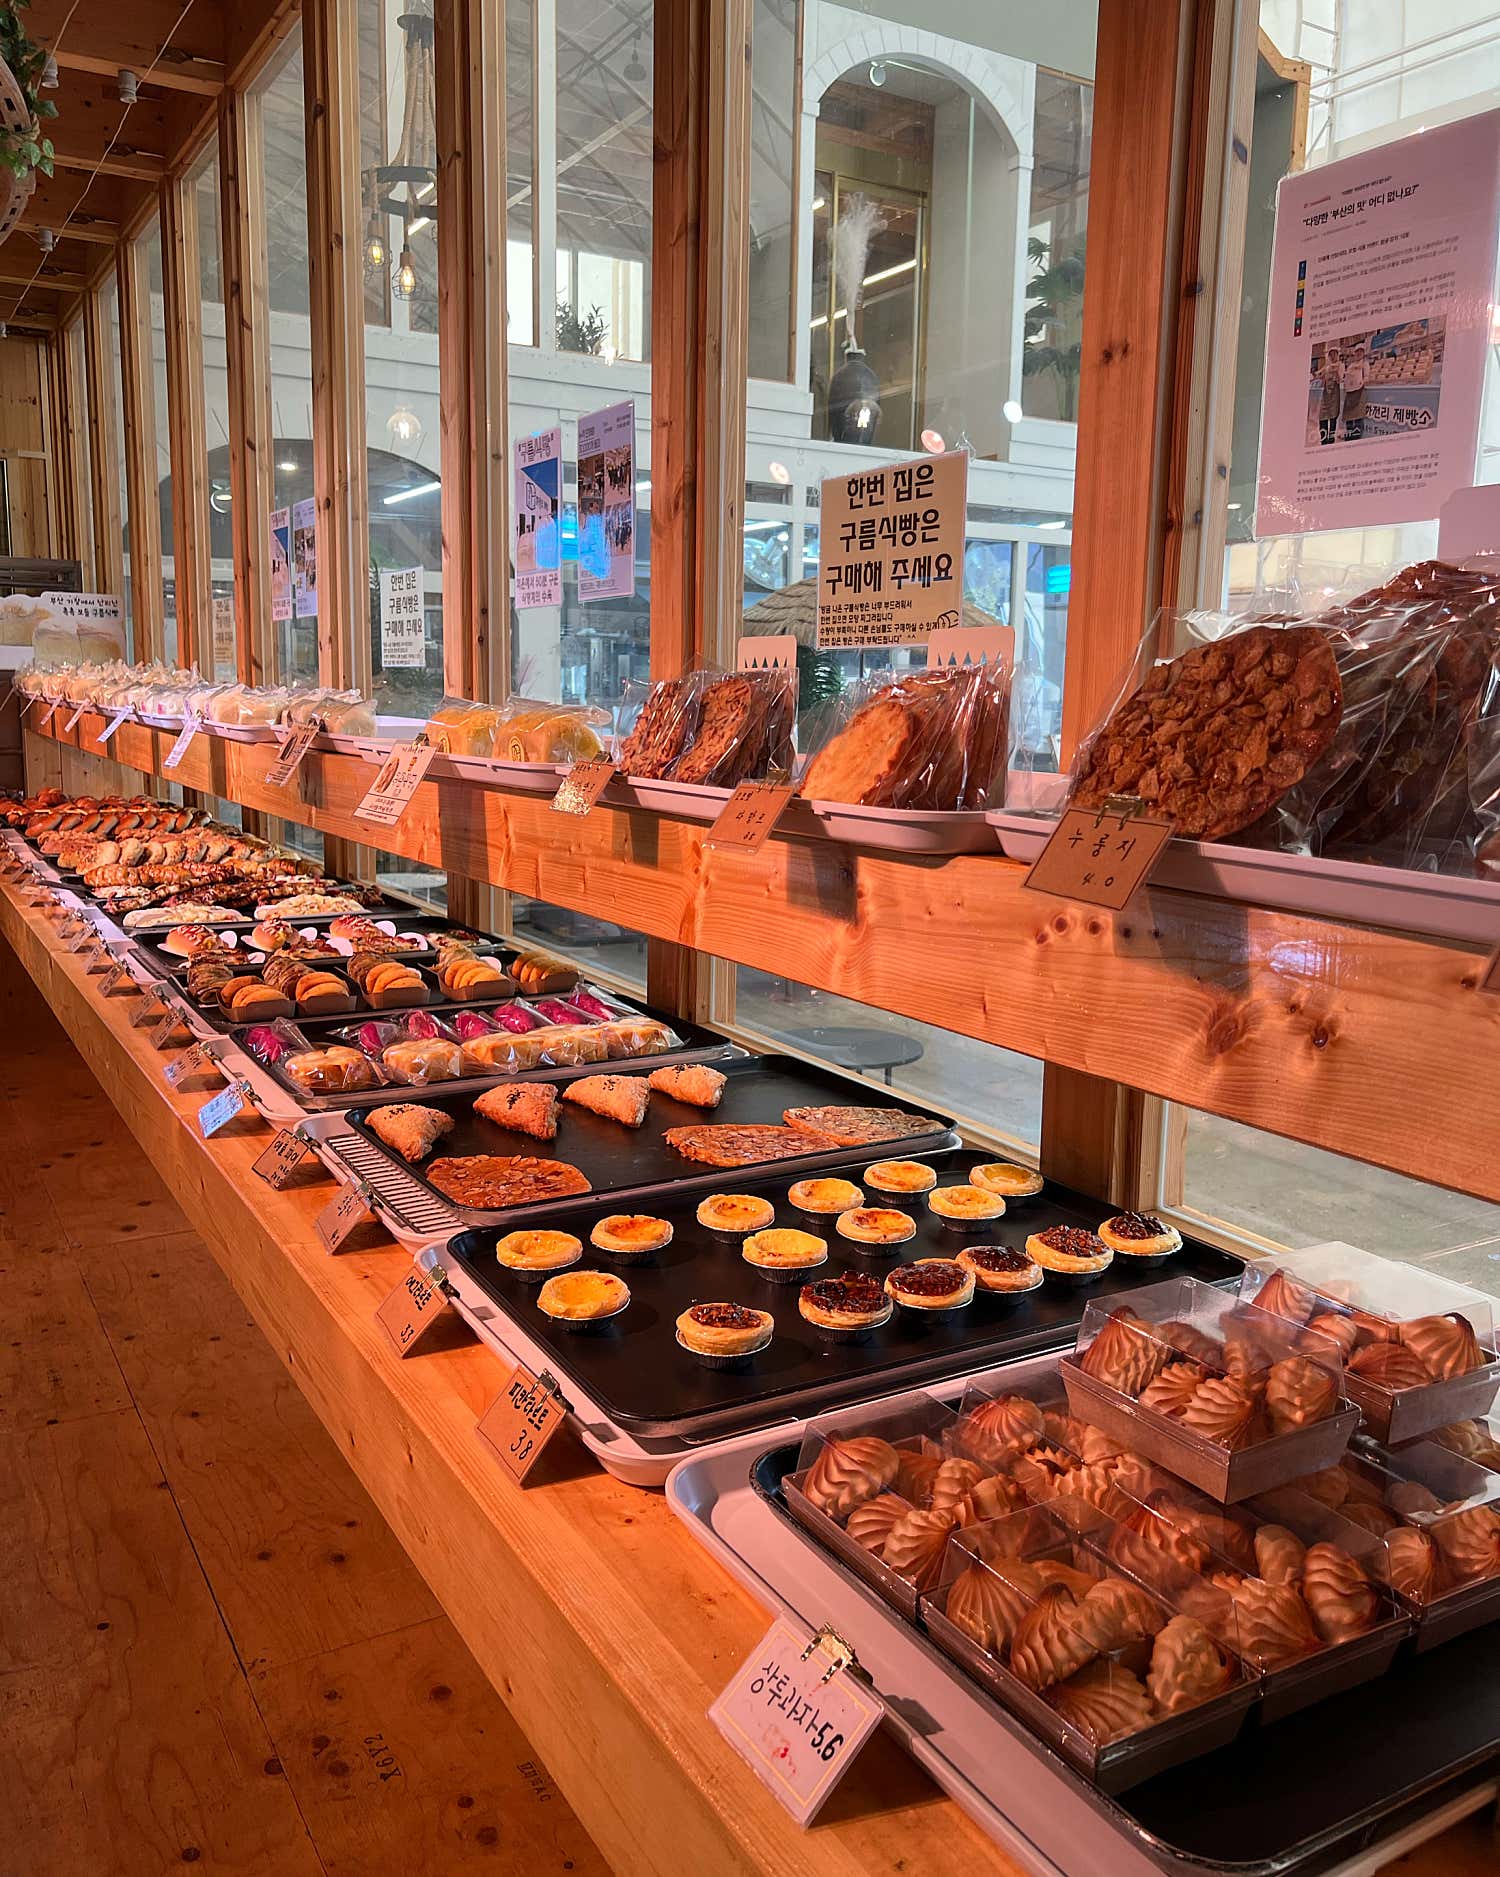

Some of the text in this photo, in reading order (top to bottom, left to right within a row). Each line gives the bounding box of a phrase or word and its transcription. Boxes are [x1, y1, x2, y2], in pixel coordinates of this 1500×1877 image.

[1369, 193, 1384, 207] 어디
[1393, 408, 1432, 426] 제빵소
[847, 464, 935, 510] 한번 집은
[840, 508, 940, 553] 구름식빵은
[825, 552, 953, 595] 구매해 주세요
[1068, 828, 1137, 862] 누룽지
[511, 1429, 533, 1461] 3.8
[750, 1661, 820, 1734] 상투과자
